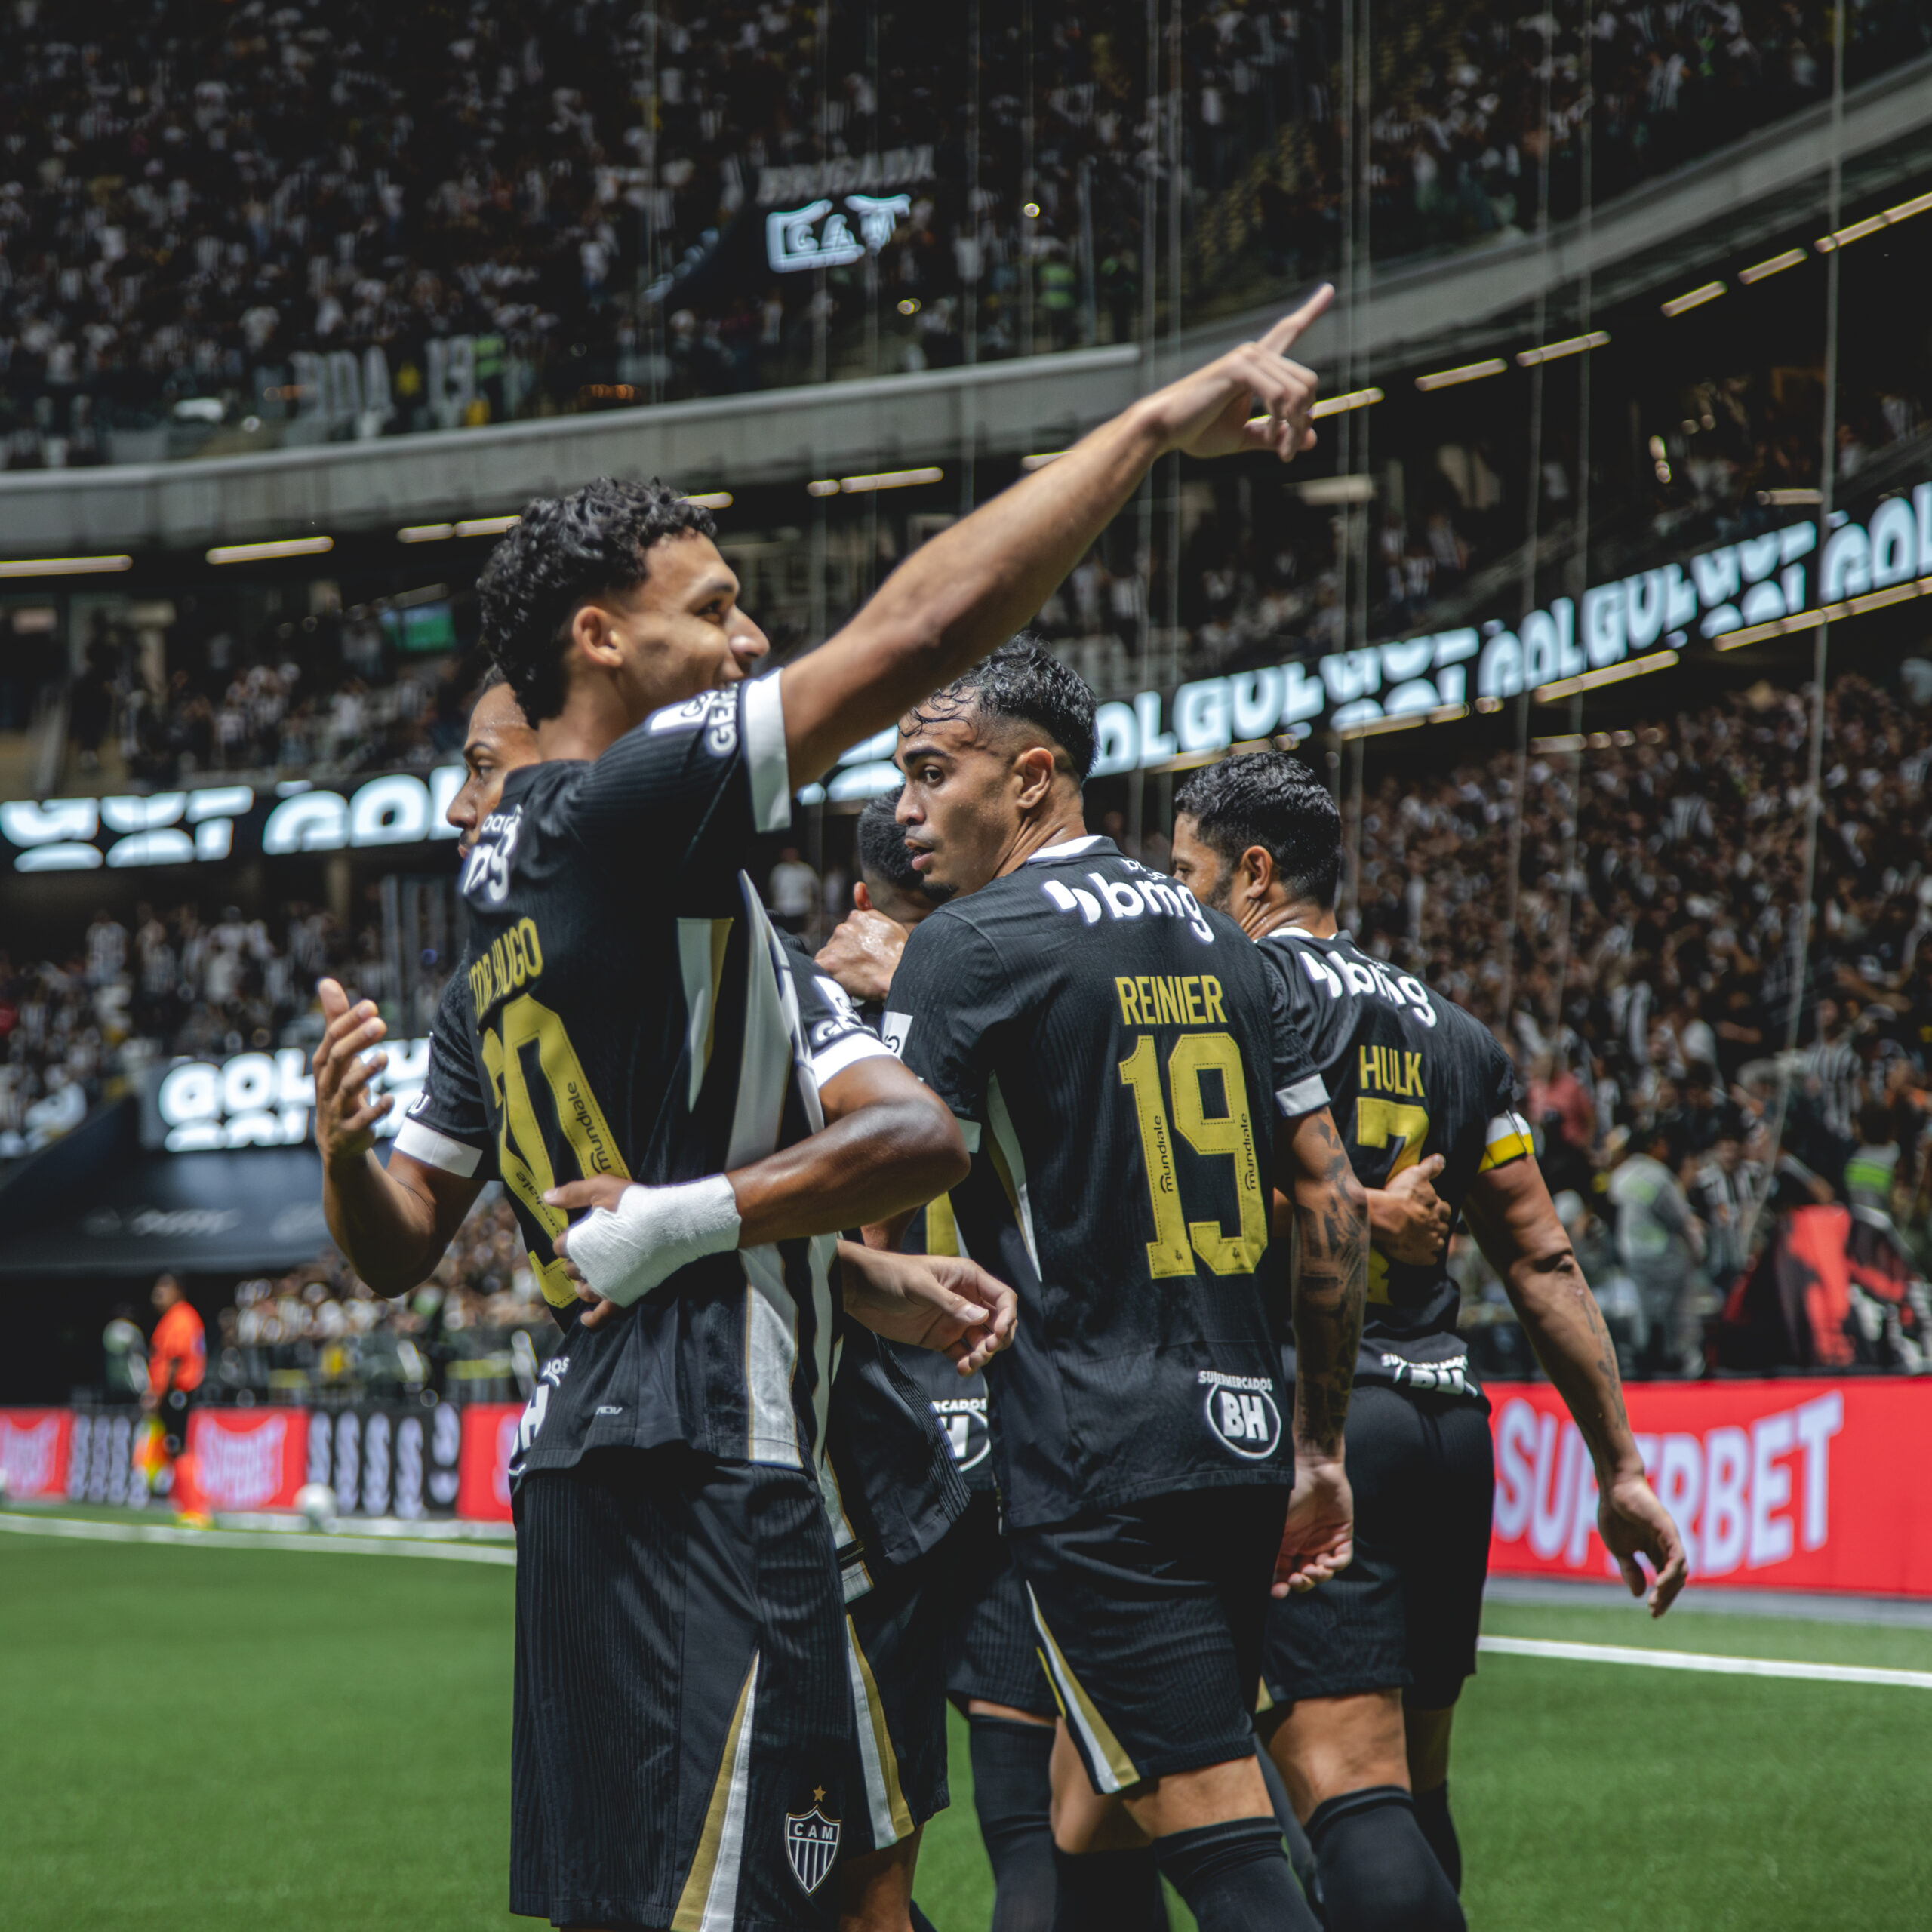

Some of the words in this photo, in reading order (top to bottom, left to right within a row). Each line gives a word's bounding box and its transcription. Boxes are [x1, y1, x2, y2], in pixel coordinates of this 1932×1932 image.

[1088, 872, 1215, 943] bmg
[491, 917, 543, 1001] HUGO
[1115, 974, 1228, 1026] REINIER
[1360, 1044, 1425, 1097] HULK
[566, 1080, 612, 1174] mundiale
[1118, 1032, 1268, 1279] 19
[1154, 1115, 1174, 1194] mundiale
[1240, 1112, 1257, 1191] mundiale
[1197, 1369, 1274, 1392] SUPERMERCADOS
[1219, 1390, 1269, 1442] BH
[1492, 1390, 1844, 1577] SUPRBET
[794, 1822, 834, 1841] CAM
